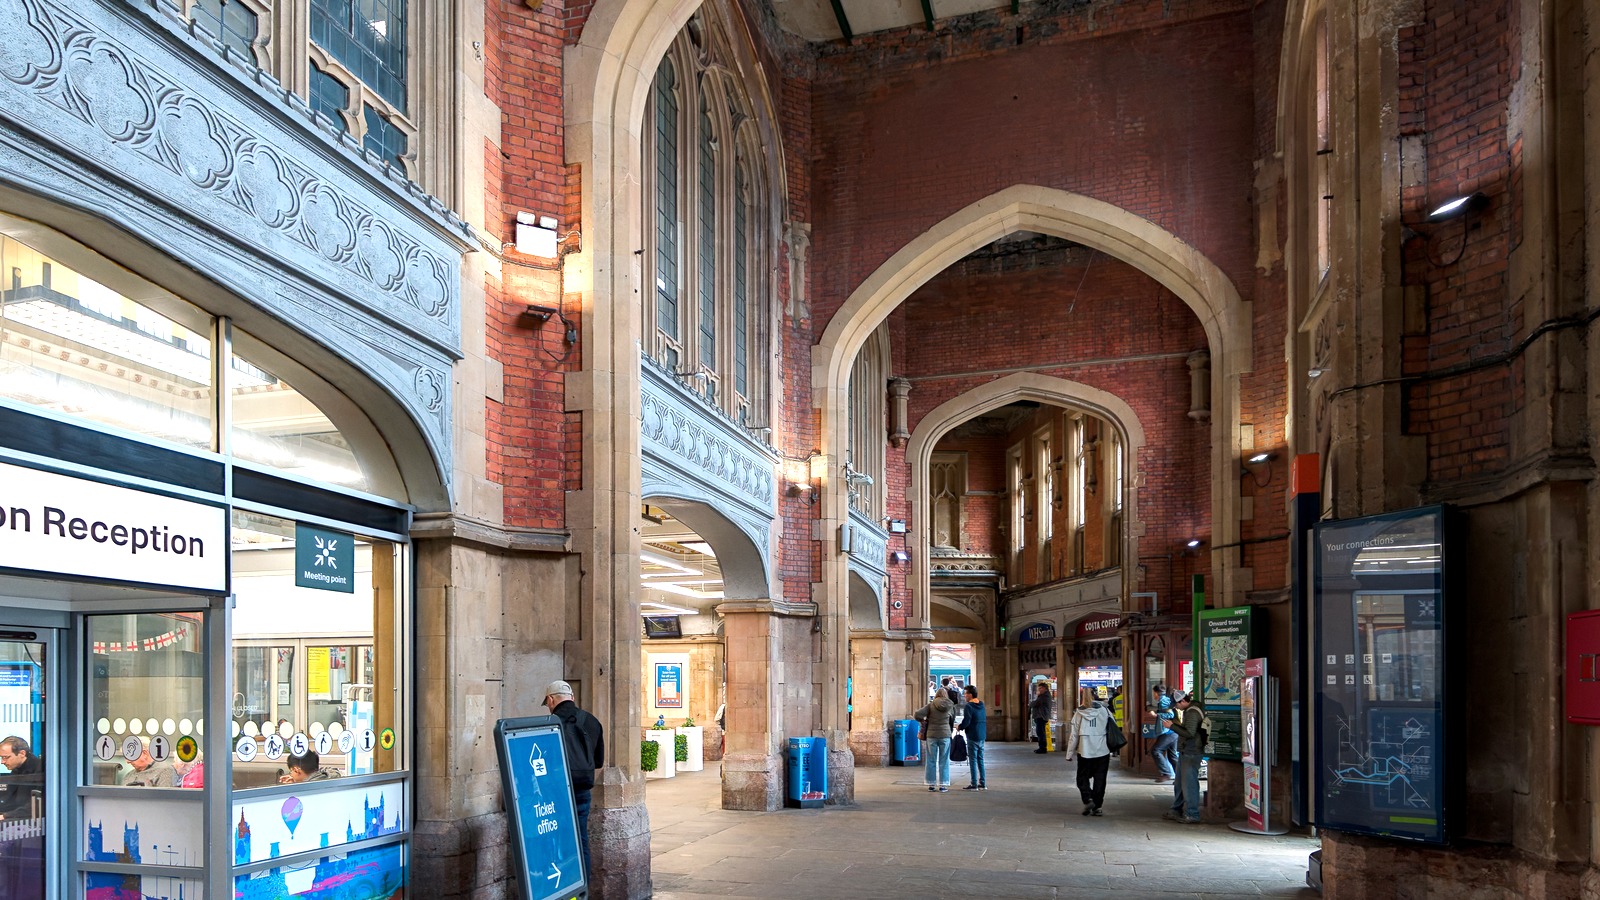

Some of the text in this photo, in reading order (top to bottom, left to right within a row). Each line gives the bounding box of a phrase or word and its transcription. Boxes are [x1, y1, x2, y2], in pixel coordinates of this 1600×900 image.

[44, 506, 204, 558] Reception
[1326, 537, 1394, 552] Your connections
[304, 570, 347, 584] Meeting point
[1085, 621, 1100, 631] COSTA
[534, 801, 556, 818] Ticket
[537, 819, 558, 835] office
